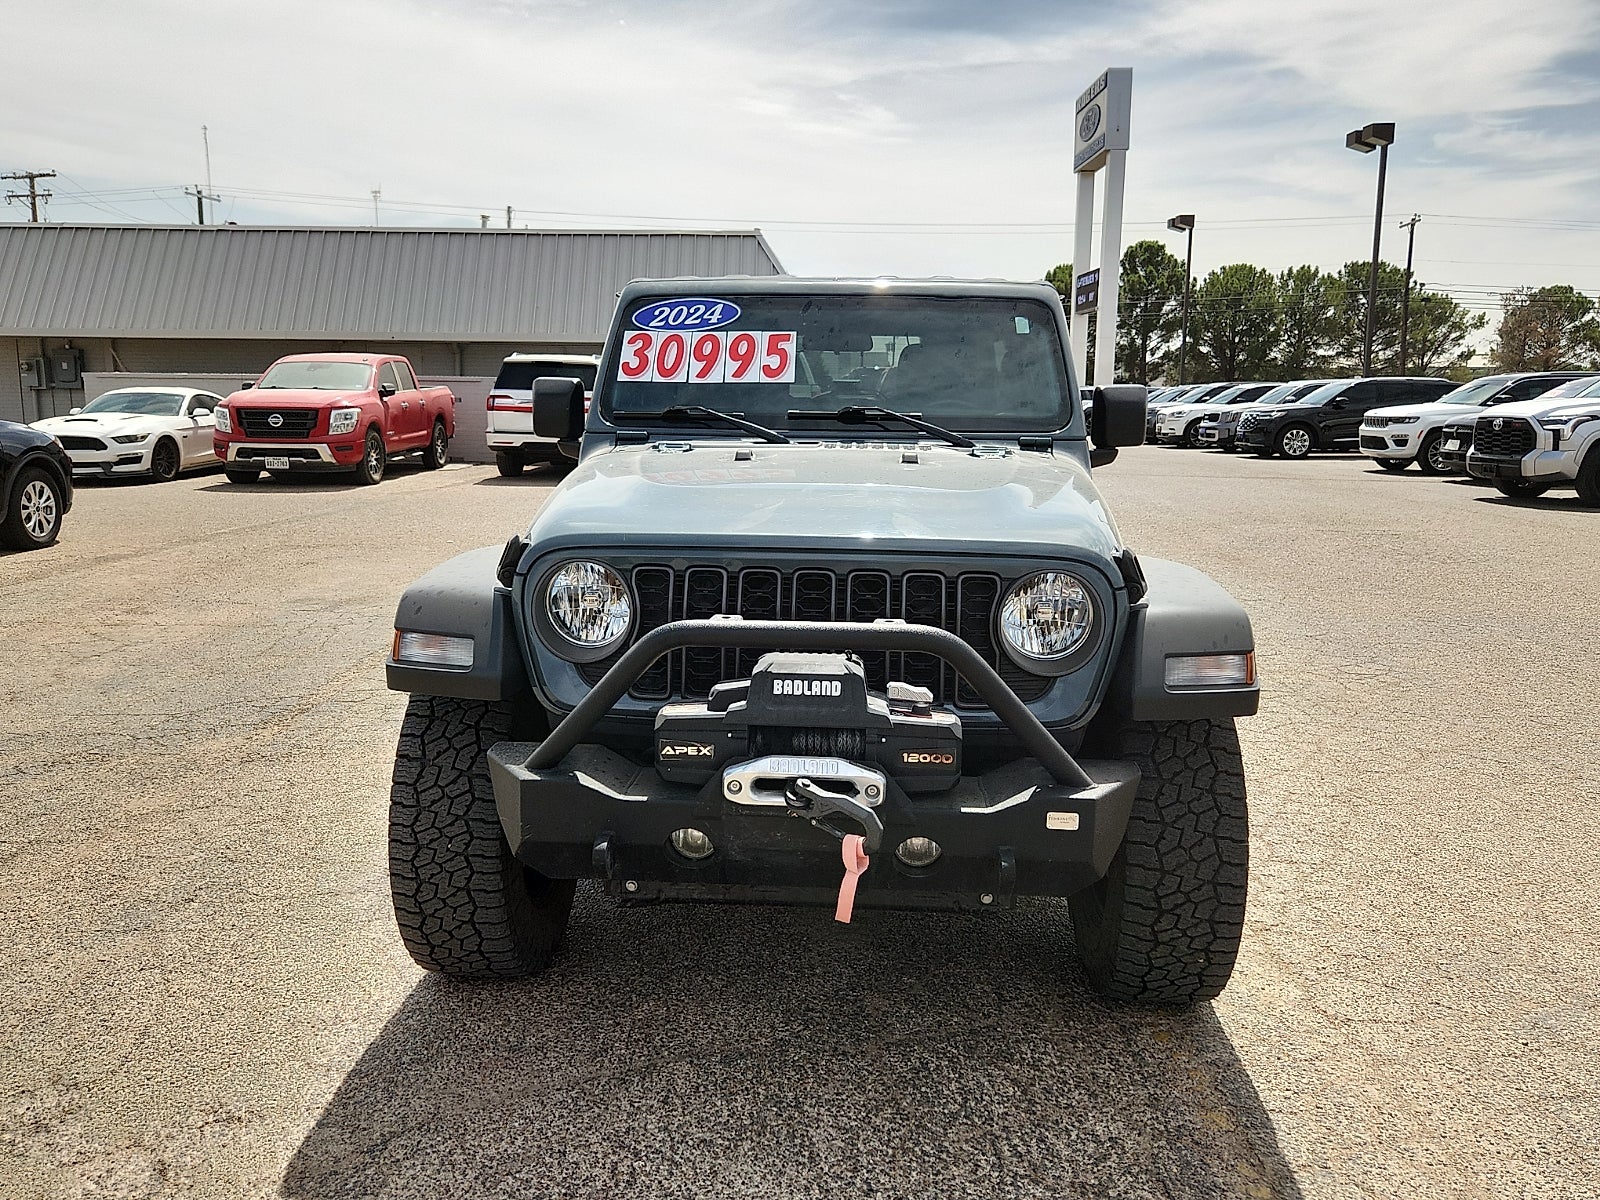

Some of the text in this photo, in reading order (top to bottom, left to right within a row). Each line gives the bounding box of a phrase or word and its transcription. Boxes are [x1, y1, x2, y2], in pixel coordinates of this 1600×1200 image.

[648, 303, 724, 327] 2024
[621, 333, 792, 379] 30995
[773, 679, 842, 696] BADLAND
[661, 746, 712, 755] APEX
[902, 752, 953, 764] 12000
[769, 759, 839, 775] BADLAND
